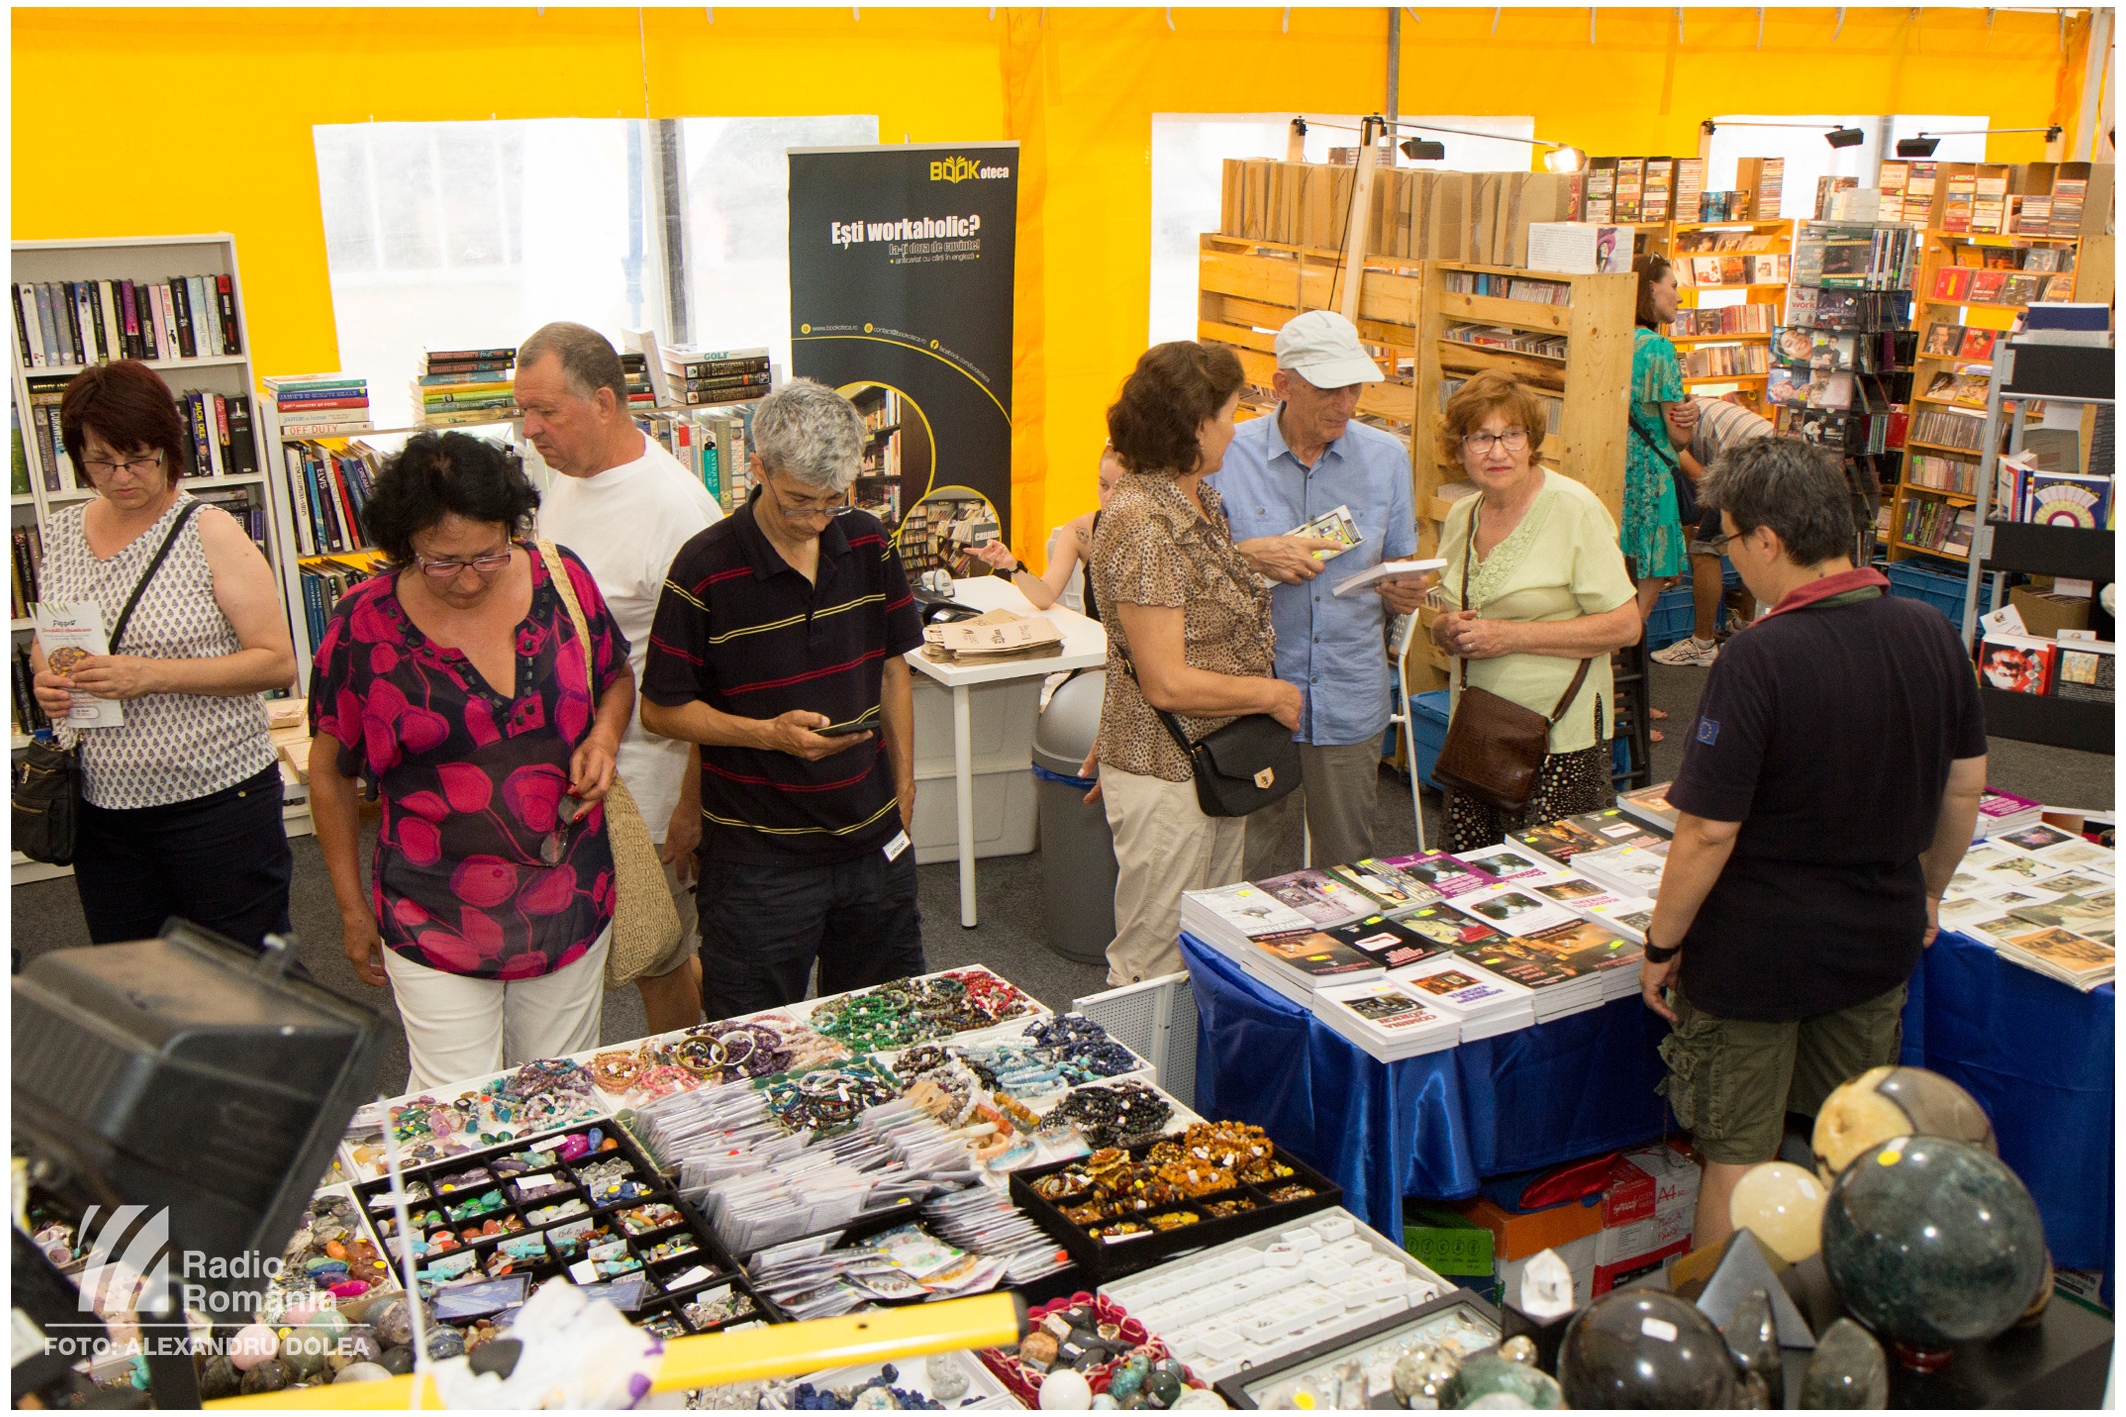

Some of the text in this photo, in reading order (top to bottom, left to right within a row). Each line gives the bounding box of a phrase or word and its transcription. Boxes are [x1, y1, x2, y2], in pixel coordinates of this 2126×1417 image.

[831, 214, 981, 250] Ești workaholic?
[909, 242, 930, 254] doza
[930, 241, 943, 253] de
[1791, 301, 1816, 309] work
[704, 351, 729, 360] GOLF
[194, 401, 206, 439] JACK DEE
[283, 415, 304, 423] jamie
[290, 424, 338, 435] OFF DUTY
[316, 468, 328, 490] ELVIS
[357, 467, 371, 490] DREAM
[1384, 1014, 1438, 1029] COMISIA
[1657, 1184, 1676, 1204] A4
